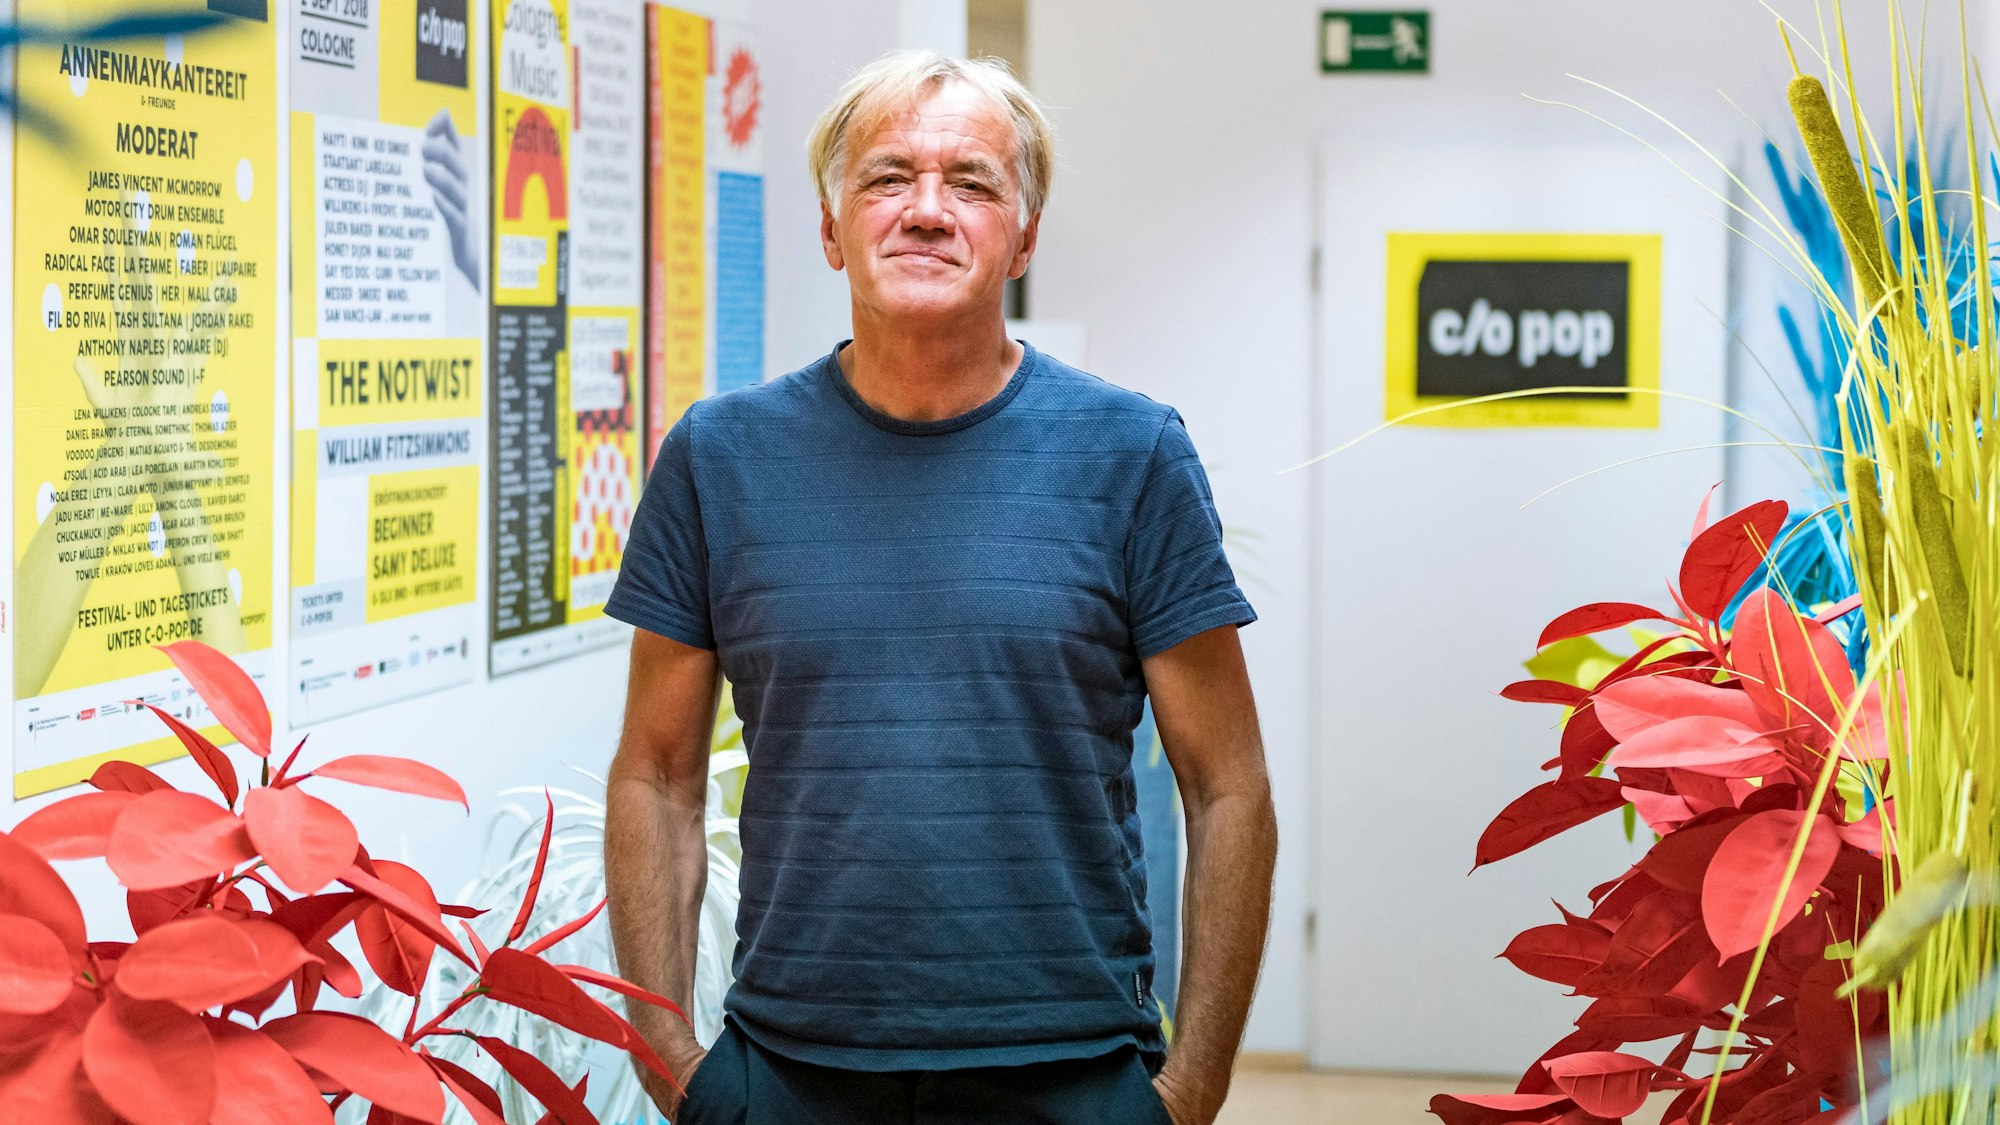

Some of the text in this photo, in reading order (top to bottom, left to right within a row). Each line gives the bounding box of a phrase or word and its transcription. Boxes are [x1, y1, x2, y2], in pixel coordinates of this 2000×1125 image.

[301, 28, 356, 60] COLOGNE
[419, 7, 466, 59] c/o pop
[59, 43, 248, 101] ANNENMAYKANTEREIT
[509, 49, 559, 99] Music
[148, 96, 176, 110] FREUNDE
[116, 122, 198, 160] MODERAT
[88, 170, 222, 198] JAMES VINCENT MCMORROW
[85, 198, 225, 225] MOTOR CITY DRUM ENSEMBLE
[70, 226, 238, 251] OMAR SOULEYMAN ROMAN FLÜGEL
[45, 254, 88, 272] RADICAL
[91, 256, 115, 274] FACE
[124, 256, 136, 274] LA
[138, 258, 172, 274] FEMME
[180, 260, 208, 276] FABER
[68, 282, 238, 303] PERFUME GENIUS HER MALL GRAB
[48, 310, 254, 331] FIL BO RIVA TASH SULTANA JORDAN RAKEI
[1429, 298, 1614, 368] c/o pop
[78, 339, 126, 356] ANTHONY
[129, 339, 165, 356] NAPLES
[172, 338, 210, 355] ROMARE
[104, 368, 206, 387] PEARSON SOUND I-F
[326, 359, 472, 406] THE NOTWIST
[74, 402, 230, 420] LENA WILLIKENS COLOGNE TAPE ANDREAS DORAU
[66, 430, 89, 440] DANIEL
[92, 427, 117, 439] BRANDT
[126, 425, 152, 437] ETERNAL
[155, 424, 190, 435] SOMETHING
[195, 421, 219, 432] THOMAS
[66, 449, 94, 460] VOODOO
[130, 445, 152, 456] MATIAS
[154, 443, 178, 455] AGUAYO
[186, 442, 197, 452] THE
[326, 430, 470, 466] WILLIAM FITZSIMMONS
[94, 468, 108, 478] ACID
[110, 466, 126, 477] ARAB
[132, 465, 142, 476] LEA
[145, 462, 178, 474] PORCELAIN
[184, 460, 206, 470] MARTIN
[50, 492, 70, 503] NOGA
[72, 490, 88, 500] EREZ
[93, 488, 112, 498] LEYYA
[118, 485, 138, 496] CLARA
[140, 482, 158, 494] MOTO
[56, 512, 72, 526] JADU
[74, 508, 94, 520] HEART
[138, 502, 154, 514] LILLY
[156, 500, 178, 512] AMONG
[180, 498, 202, 509] CLOUDS
[56, 528, 102, 543] CHUCKAMUCK
[107, 526, 125, 540] JOSIN
[130, 522, 156, 536] JACQUES
[162, 518, 179, 530] AGAR
[180, 517, 194, 528] AGAR
[200, 514, 222, 526] TRISTAN
[374, 512, 433, 543] BEGINNER
[58, 550, 77, 563] WOLF
[80, 546, 104, 560] MÜLLER
[113, 543, 136, 556] NIKLAS
[137, 540, 159, 552] WANDT
[192, 535, 208, 546] CREW
[134, 560, 154, 572] LOVES
[184, 554, 196, 565] UND
[198, 552, 212, 562] VIELE
[215, 550, 230, 560] MEHR
[374, 544, 456, 579] SAMY DELUXE
[78, 587, 228, 629] FESTIVAL- UND TAGESTICKETS
[107, 618, 203, 651] UNTER C-O-POP.DE
